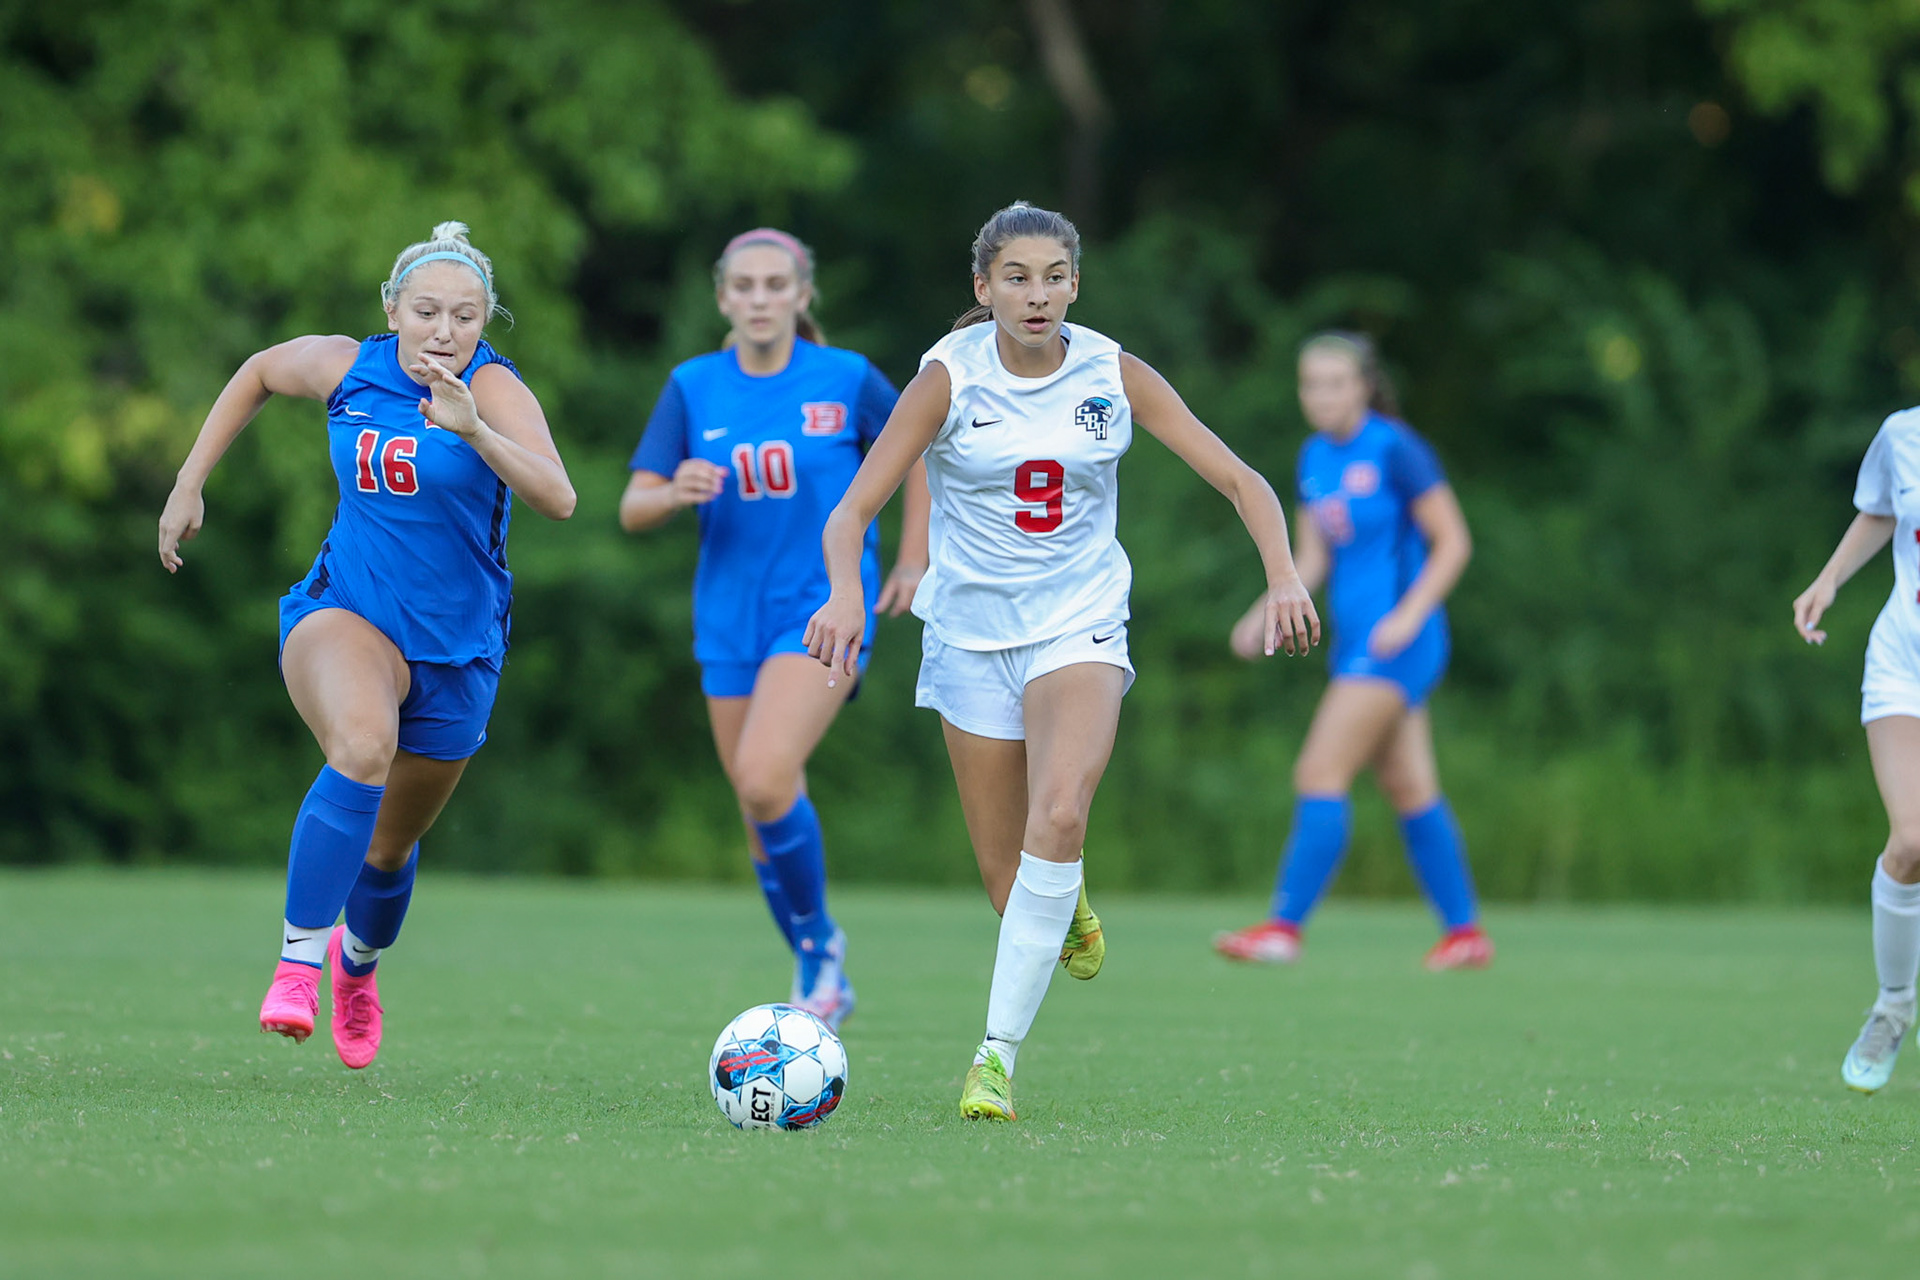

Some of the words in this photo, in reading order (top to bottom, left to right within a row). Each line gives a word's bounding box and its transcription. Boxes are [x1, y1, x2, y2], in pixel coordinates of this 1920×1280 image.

[801, 401, 848, 437] B
[1075, 405, 1107, 440] SBA
[355, 428, 420, 496] 16
[731, 440, 798, 501] 10
[1014, 459, 1065, 533] 9
